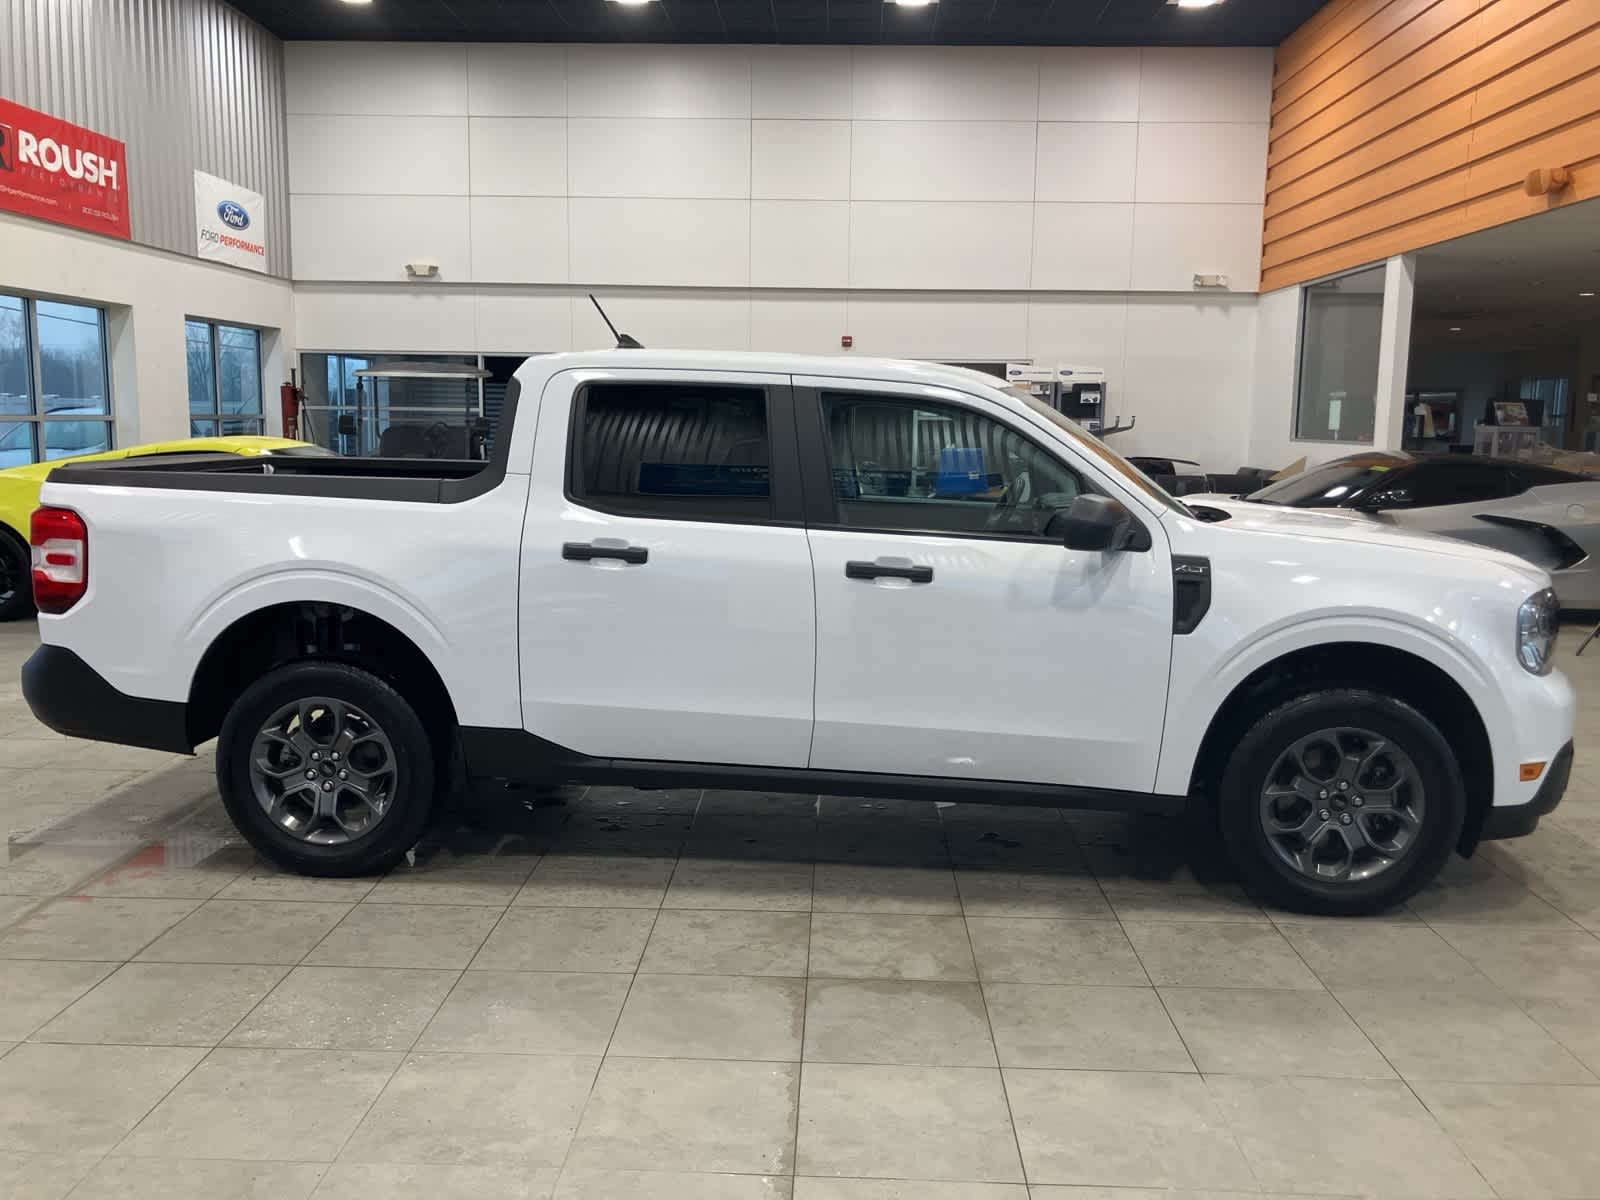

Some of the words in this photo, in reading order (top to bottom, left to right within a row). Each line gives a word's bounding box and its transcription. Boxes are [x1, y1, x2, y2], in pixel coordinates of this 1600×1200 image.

[18, 129, 118, 190] ROUSH
[200, 229, 219, 243] FORD
[220, 234, 265, 256] PERFORMANCE
